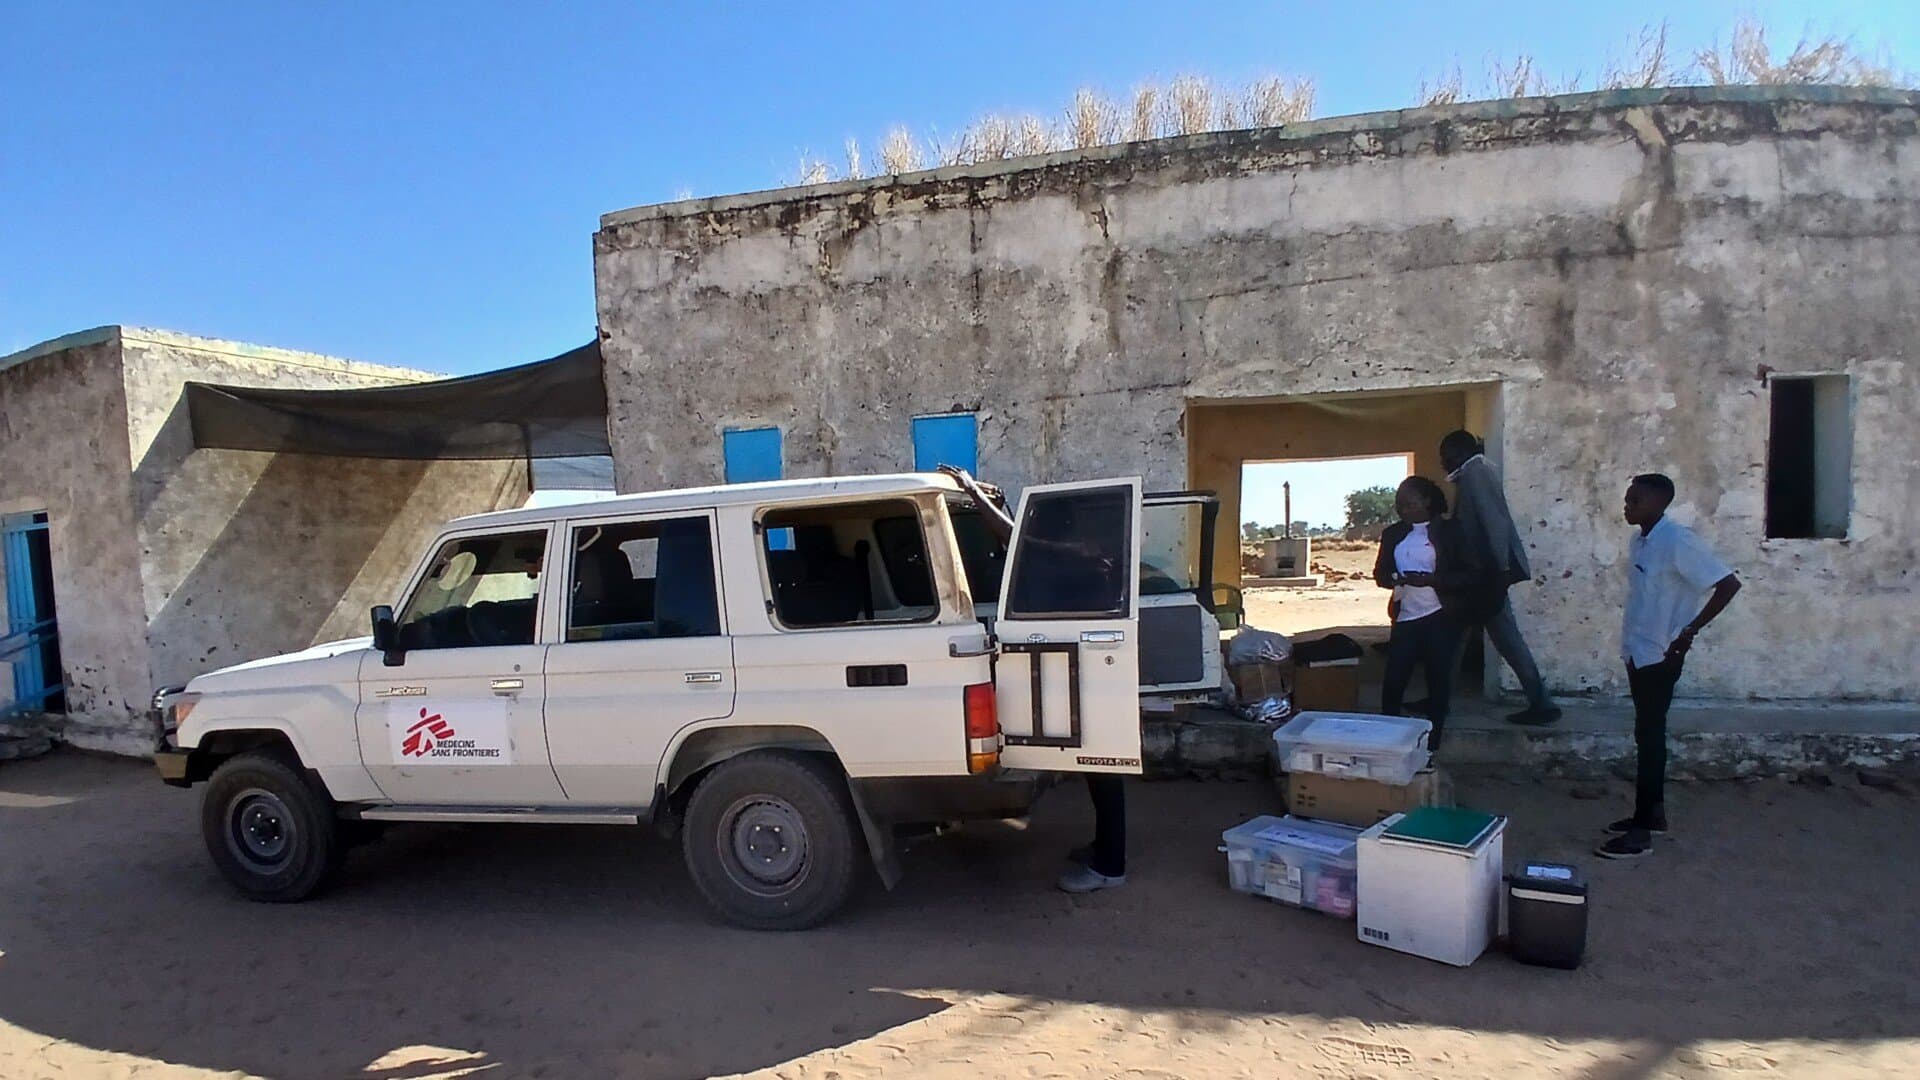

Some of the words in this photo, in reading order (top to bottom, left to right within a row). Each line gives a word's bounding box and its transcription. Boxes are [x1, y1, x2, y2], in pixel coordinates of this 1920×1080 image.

[436, 740, 475, 748] MEDECINS
[431, 749, 451, 757] SANS
[452, 749, 500, 757] FRONTIERES
[1078, 757, 1115, 765] TOYOTA
